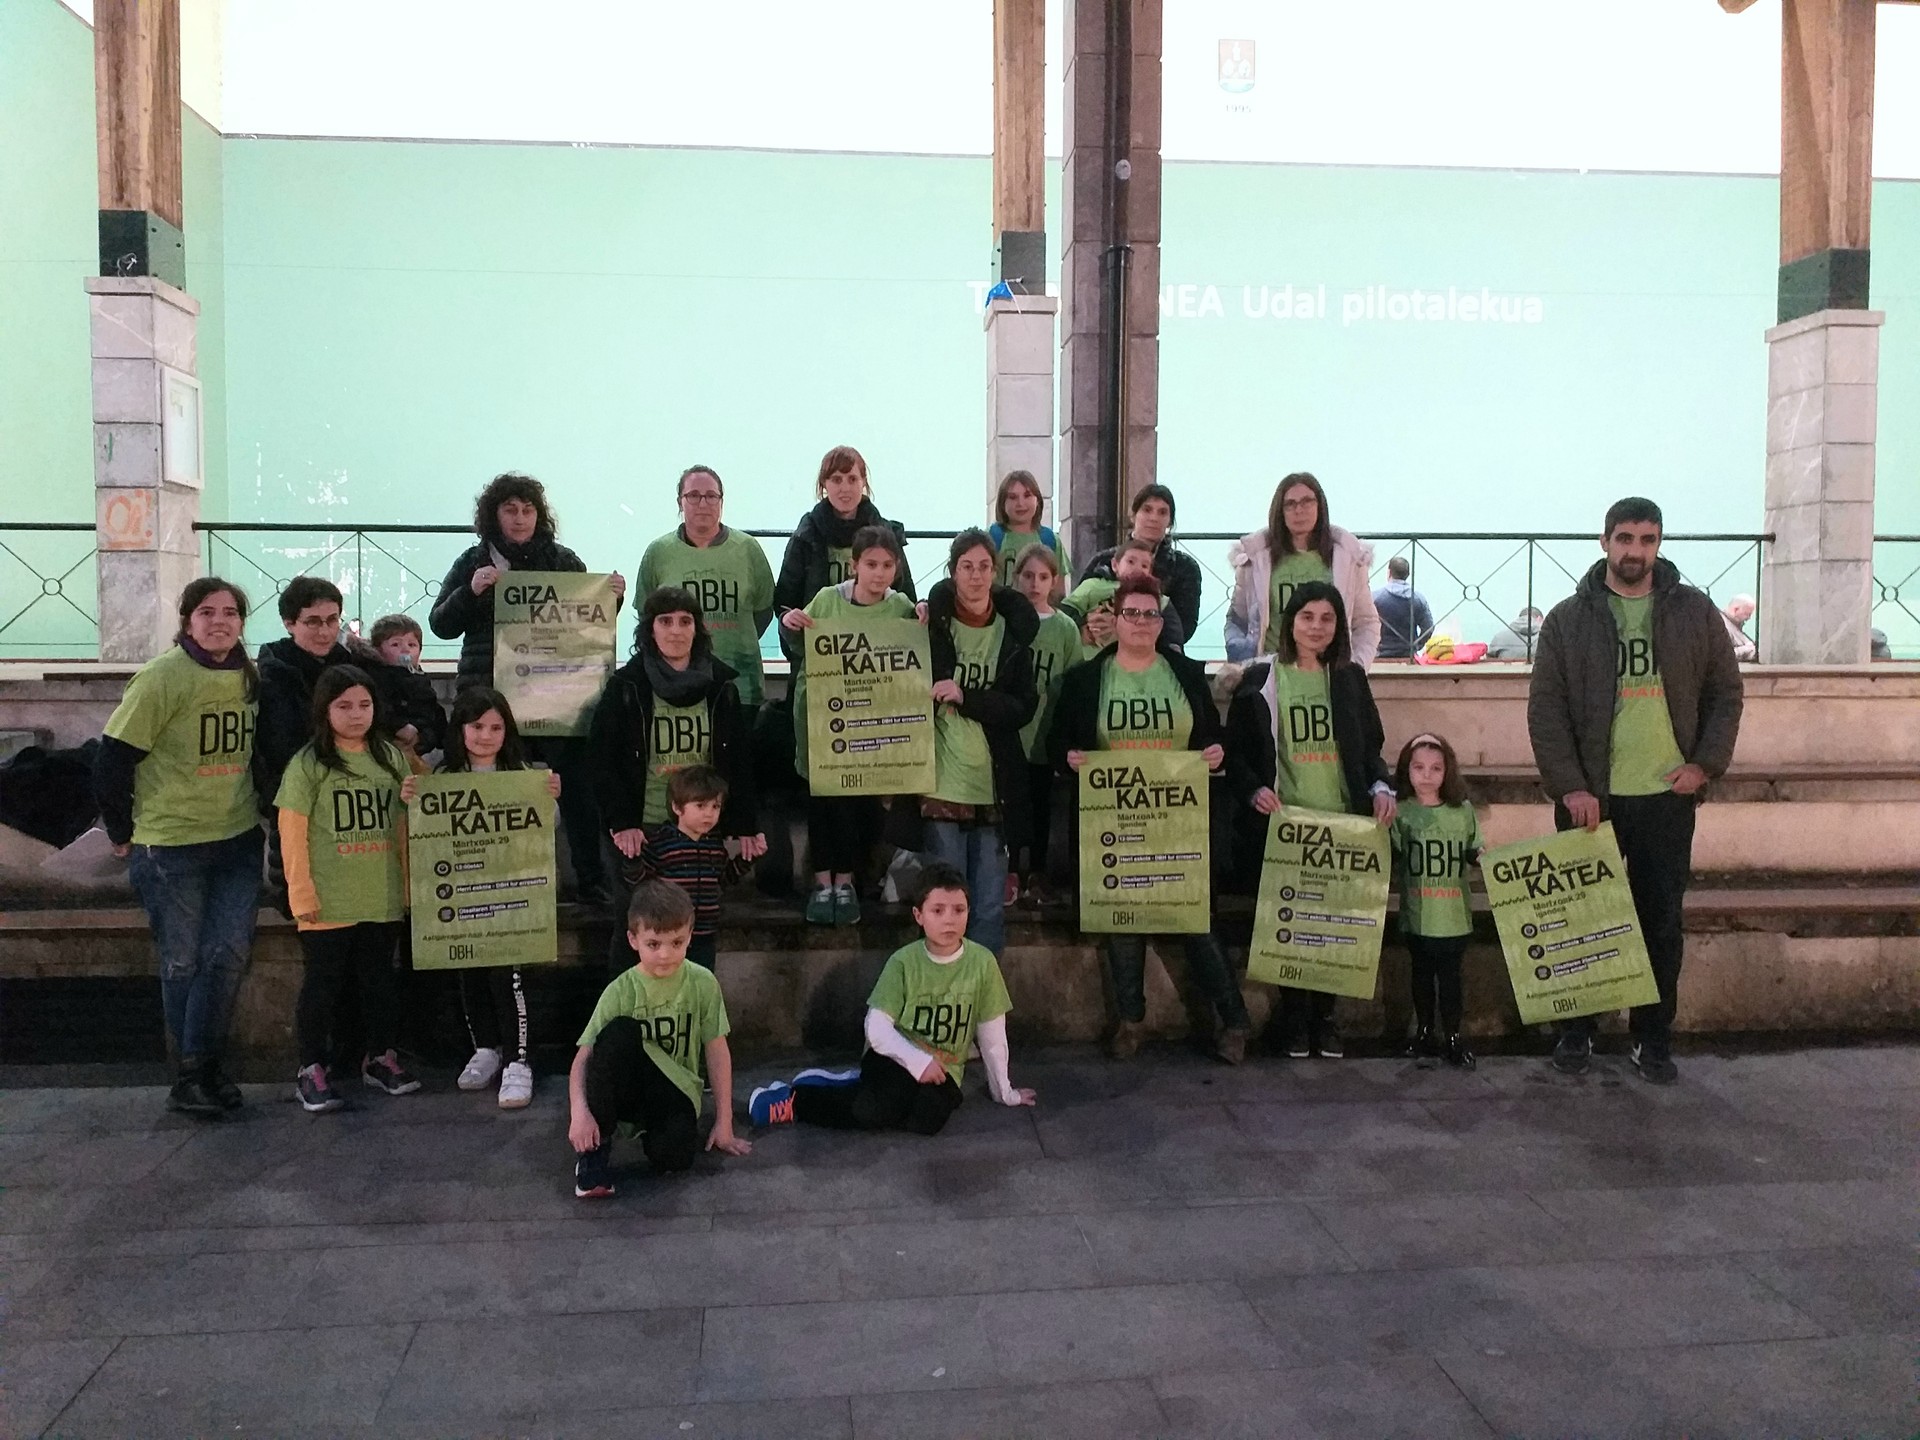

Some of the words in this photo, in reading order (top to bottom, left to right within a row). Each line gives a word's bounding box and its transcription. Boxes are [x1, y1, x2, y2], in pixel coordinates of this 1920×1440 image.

[1243, 284, 1326, 319] Udal
[1342, 284, 1544, 328] pilotalekua
[504, 586, 559, 605] GIZA
[530, 604, 607, 624] KATEA
[814, 632, 872, 656] GIZA
[842, 650, 922, 675] KATEA
[844, 676, 881, 686] Martxoak
[1107, 698, 1174, 731] DBH
[1289, 705, 1335, 743] DB
[200, 710, 255, 756] DBH
[654, 715, 711, 754] DBH
[1293, 752, 1338, 764] ORAI
[841, 774, 862, 788] DBH
[1089, 766, 1147, 789] GIZA
[420, 789, 486, 815] GIZA
[1116, 786, 1198, 809] KATEA
[332, 788, 392, 832] DBH
[451, 806, 543, 836] KATEA
[1117, 813, 1156, 821] Martxoak
[453, 837, 496, 848] Martxoak
[499, 836, 510, 844] 29
[1277, 822, 1334, 847] GIZA
[1301, 846, 1381, 873] KATEA
[1408, 840, 1464, 878] DBH
[1492, 852, 1556, 884] GIZA
[1525, 860, 1615, 899] KATEA
[1533, 896, 1573, 911] Martxoak
[1112, 911, 1134, 925] DBH
[449, 944, 474, 961] DBH
[1280, 964, 1302, 980] DBH
[1553, 997, 1578, 1014] DBH
[912, 1004, 972, 1045] DBH
